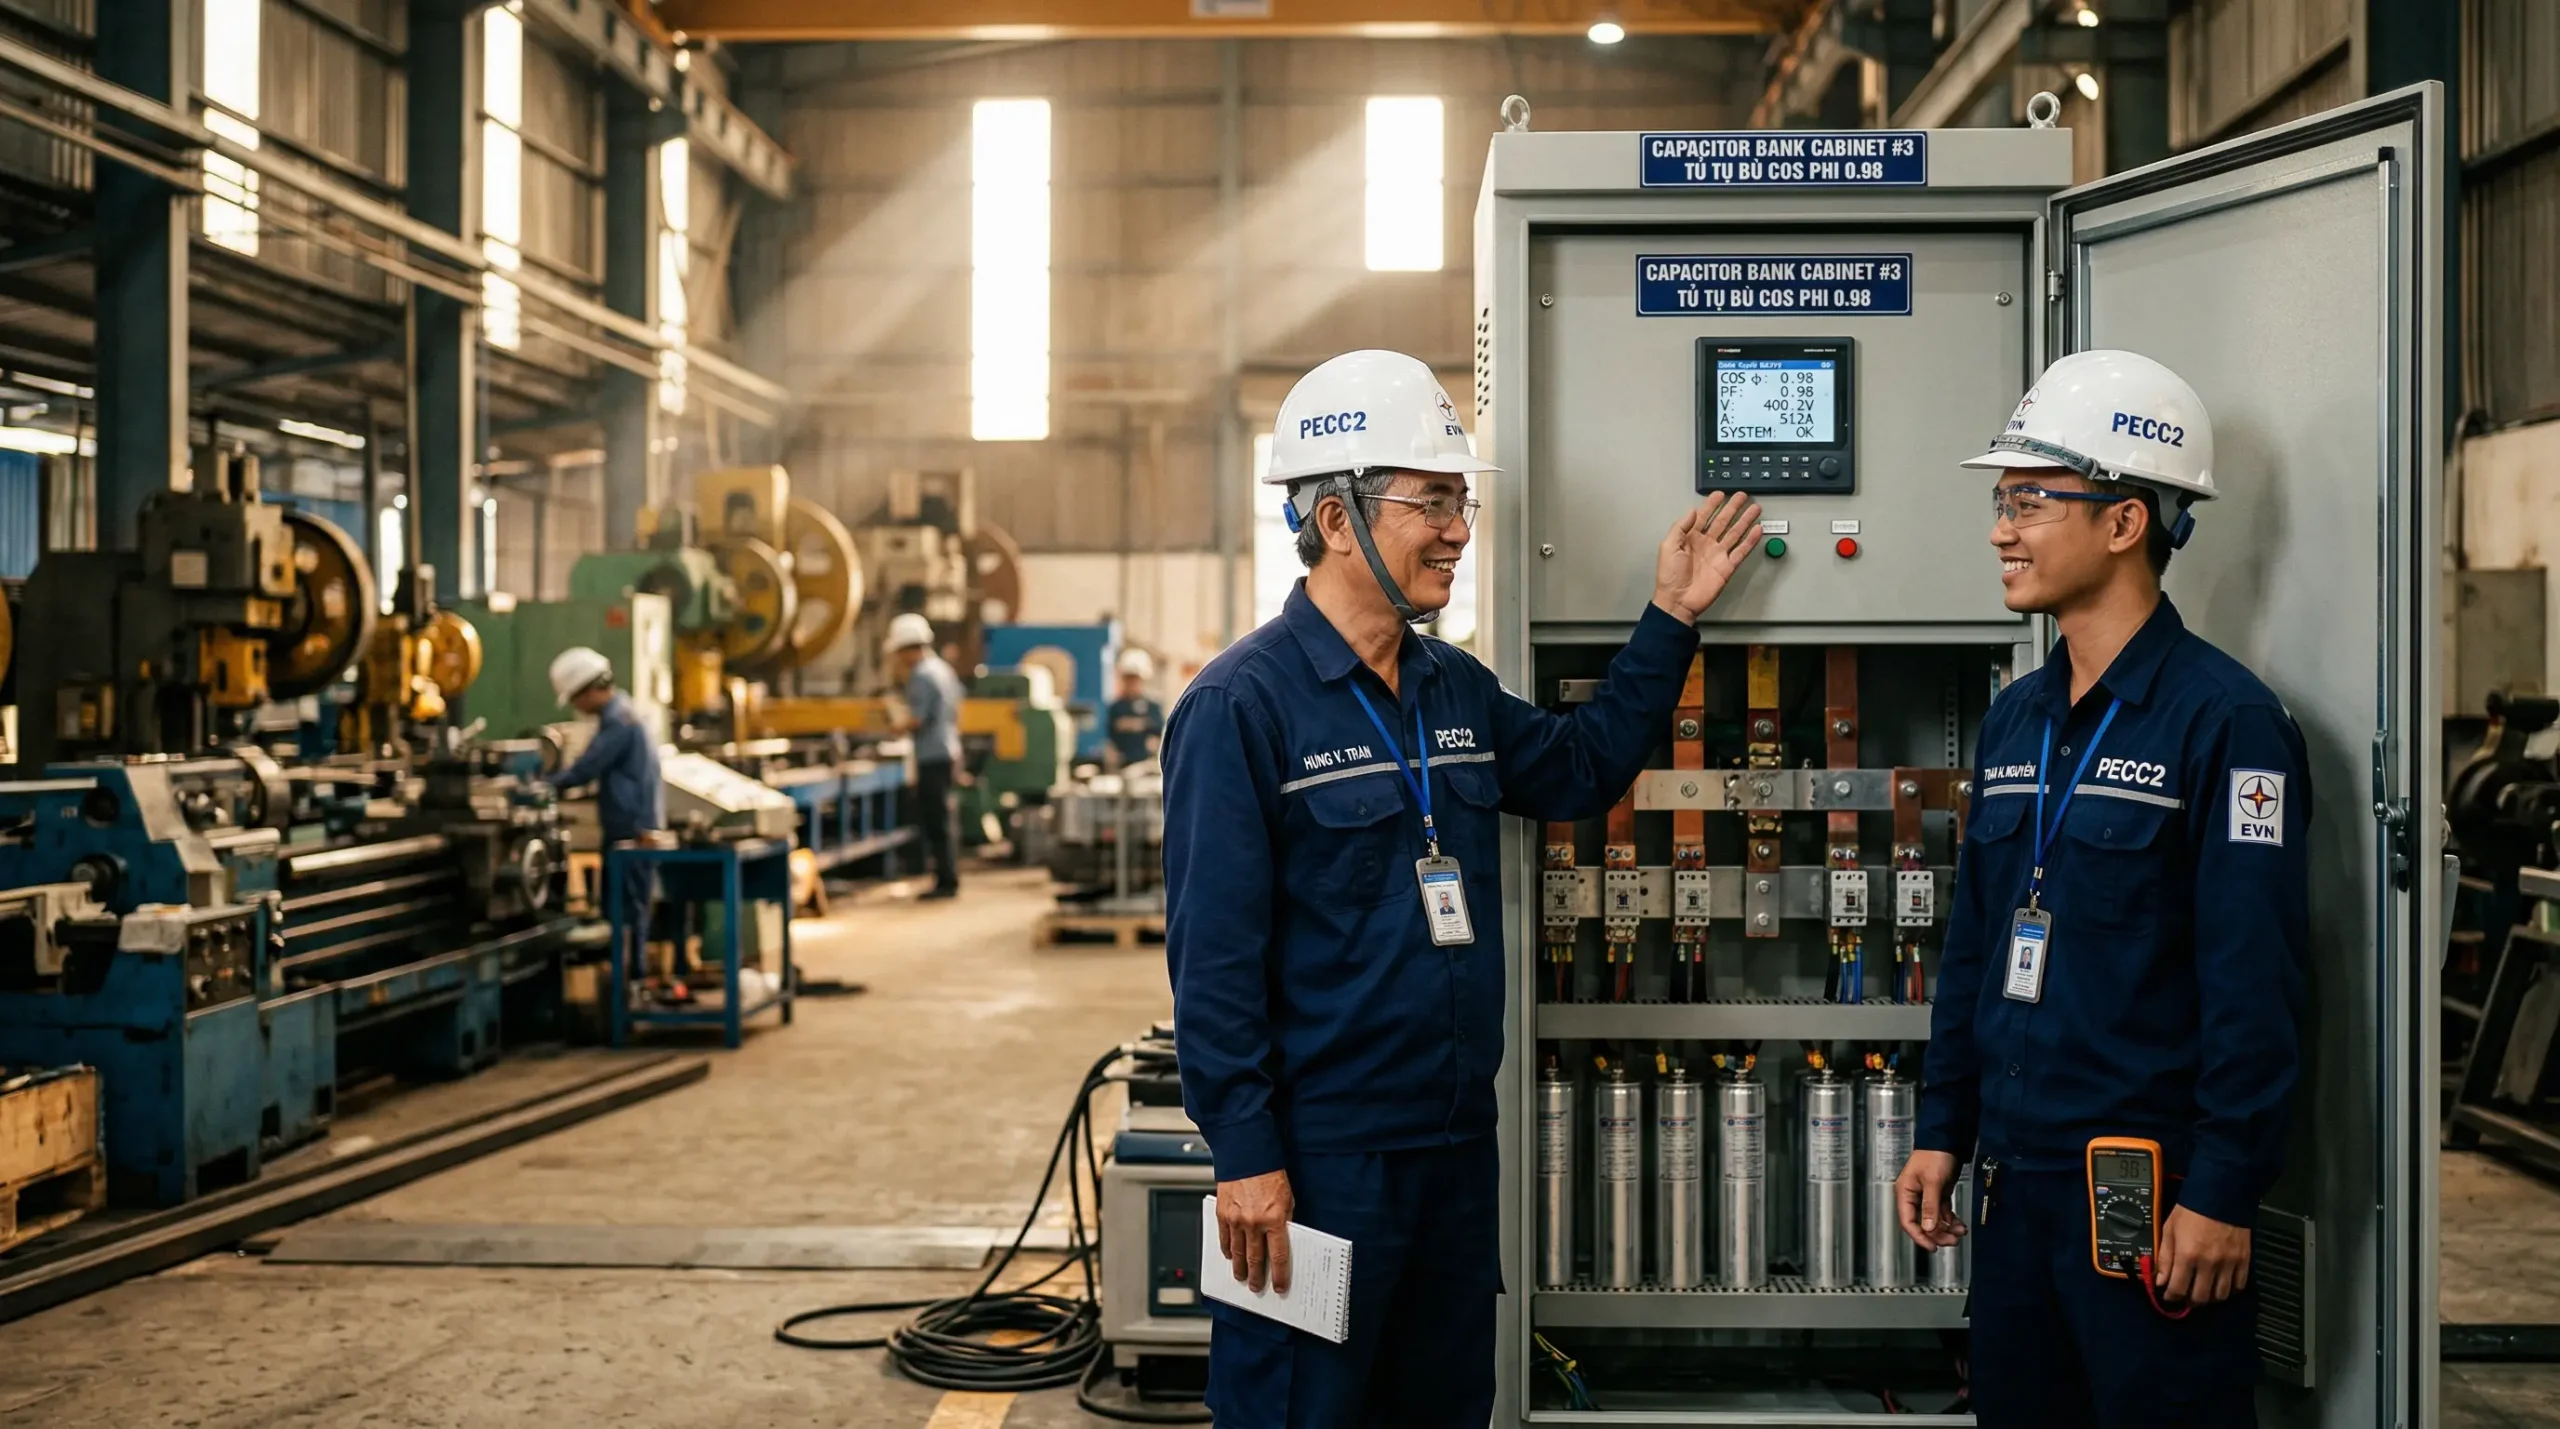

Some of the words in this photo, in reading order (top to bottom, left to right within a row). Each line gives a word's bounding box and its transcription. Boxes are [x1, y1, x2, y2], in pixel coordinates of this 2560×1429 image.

[1652, 139, 1750, 158] CAPACITOR
[1756, 139, 1805, 157] BANK
[1811, 139, 1887, 157] CABINET
[1892, 138, 1914, 156] #3
[1684, 156, 1707, 181] TỦ
[1711, 162, 1733, 183] TỤ
[1739, 158, 1763, 180] BÙ
[1768, 162, 1804, 180] COS
[1809, 162, 1839, 180] PHI
[1844, 162, 1883, 180] 0.98
[1646, 263, 1742, 281] CAPACITOR
[1747, 263, 1796, 281] BANK
[1800, 263, 1875, 281] CABINET
[1879, 263, 1902, 280] #3
[1677, 283, 1699, 307] TỦ
[1704, 289, 1726, 311] TỤ
[1730, 285, 1754, 307] BÙ
[1759, 289, 1794, 307] COS
[1800, 289, 1829, 307] PHI
[1833, 289, 1871, 307] 0.98
[1720, 372, 1746, 384] COS
[1780, 372, 1814, 384] 0.98
[1720, 386, 1743, 397] PF:
[1780, 386, 1814, 397] 0.98
[1720, 399, 1735, 411] V:
[1763, 399, 1814, 411] 400.2V
[1300, 411, 1367, 440] PECC2
[1720, 413, 1734, 425] A:
[1780, 413, 1814, 425] 512A
[1720, 427, 1777, 438] SYSTEM:
[1796, 427, 1814, 438] OK
[2112, 412, 2184, 447] PECC2
[1303, 751, 1334, 770] HUNG
[2095, 757, 2166, 788] PECC2
[2241, 823, 2275, 839] EVN
